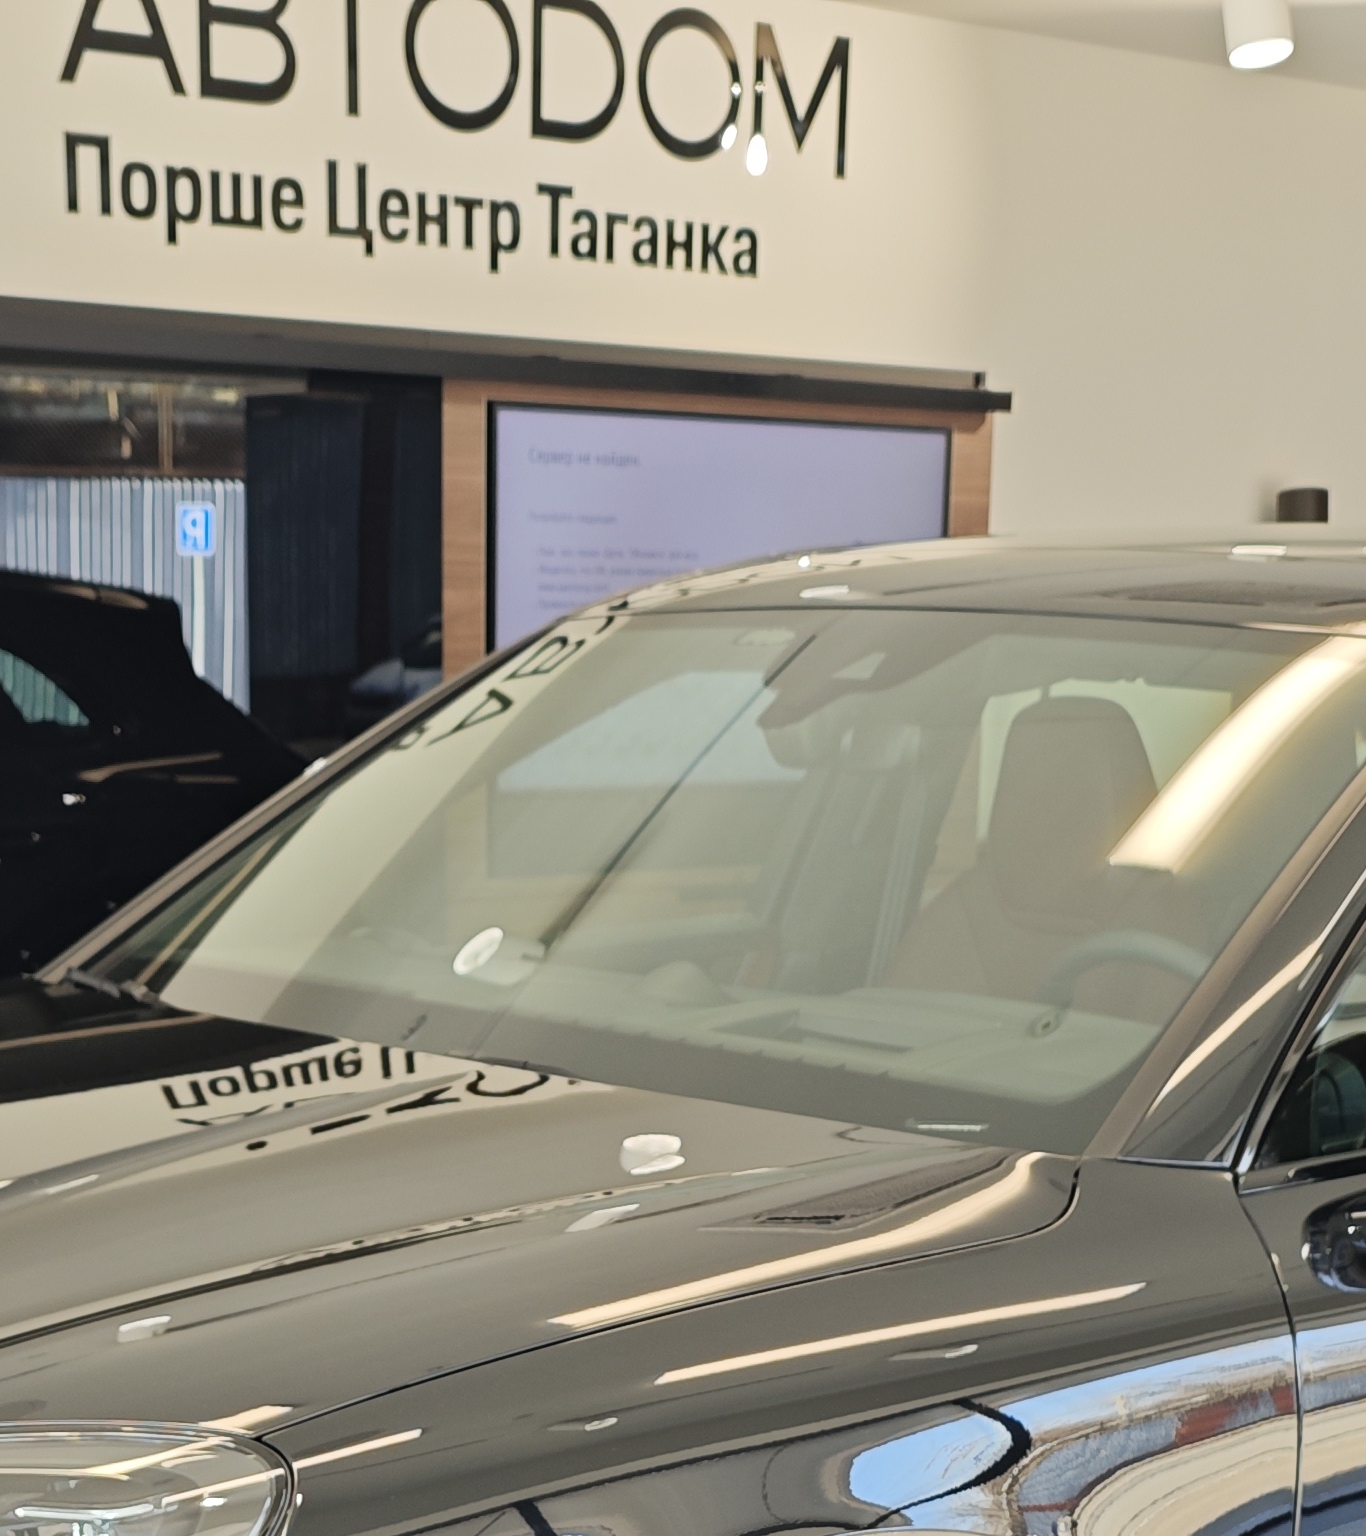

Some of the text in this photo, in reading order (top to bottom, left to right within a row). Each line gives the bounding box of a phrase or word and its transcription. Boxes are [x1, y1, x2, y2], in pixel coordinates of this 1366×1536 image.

[64, 132, 760, 279] Порше Центр Таганка
